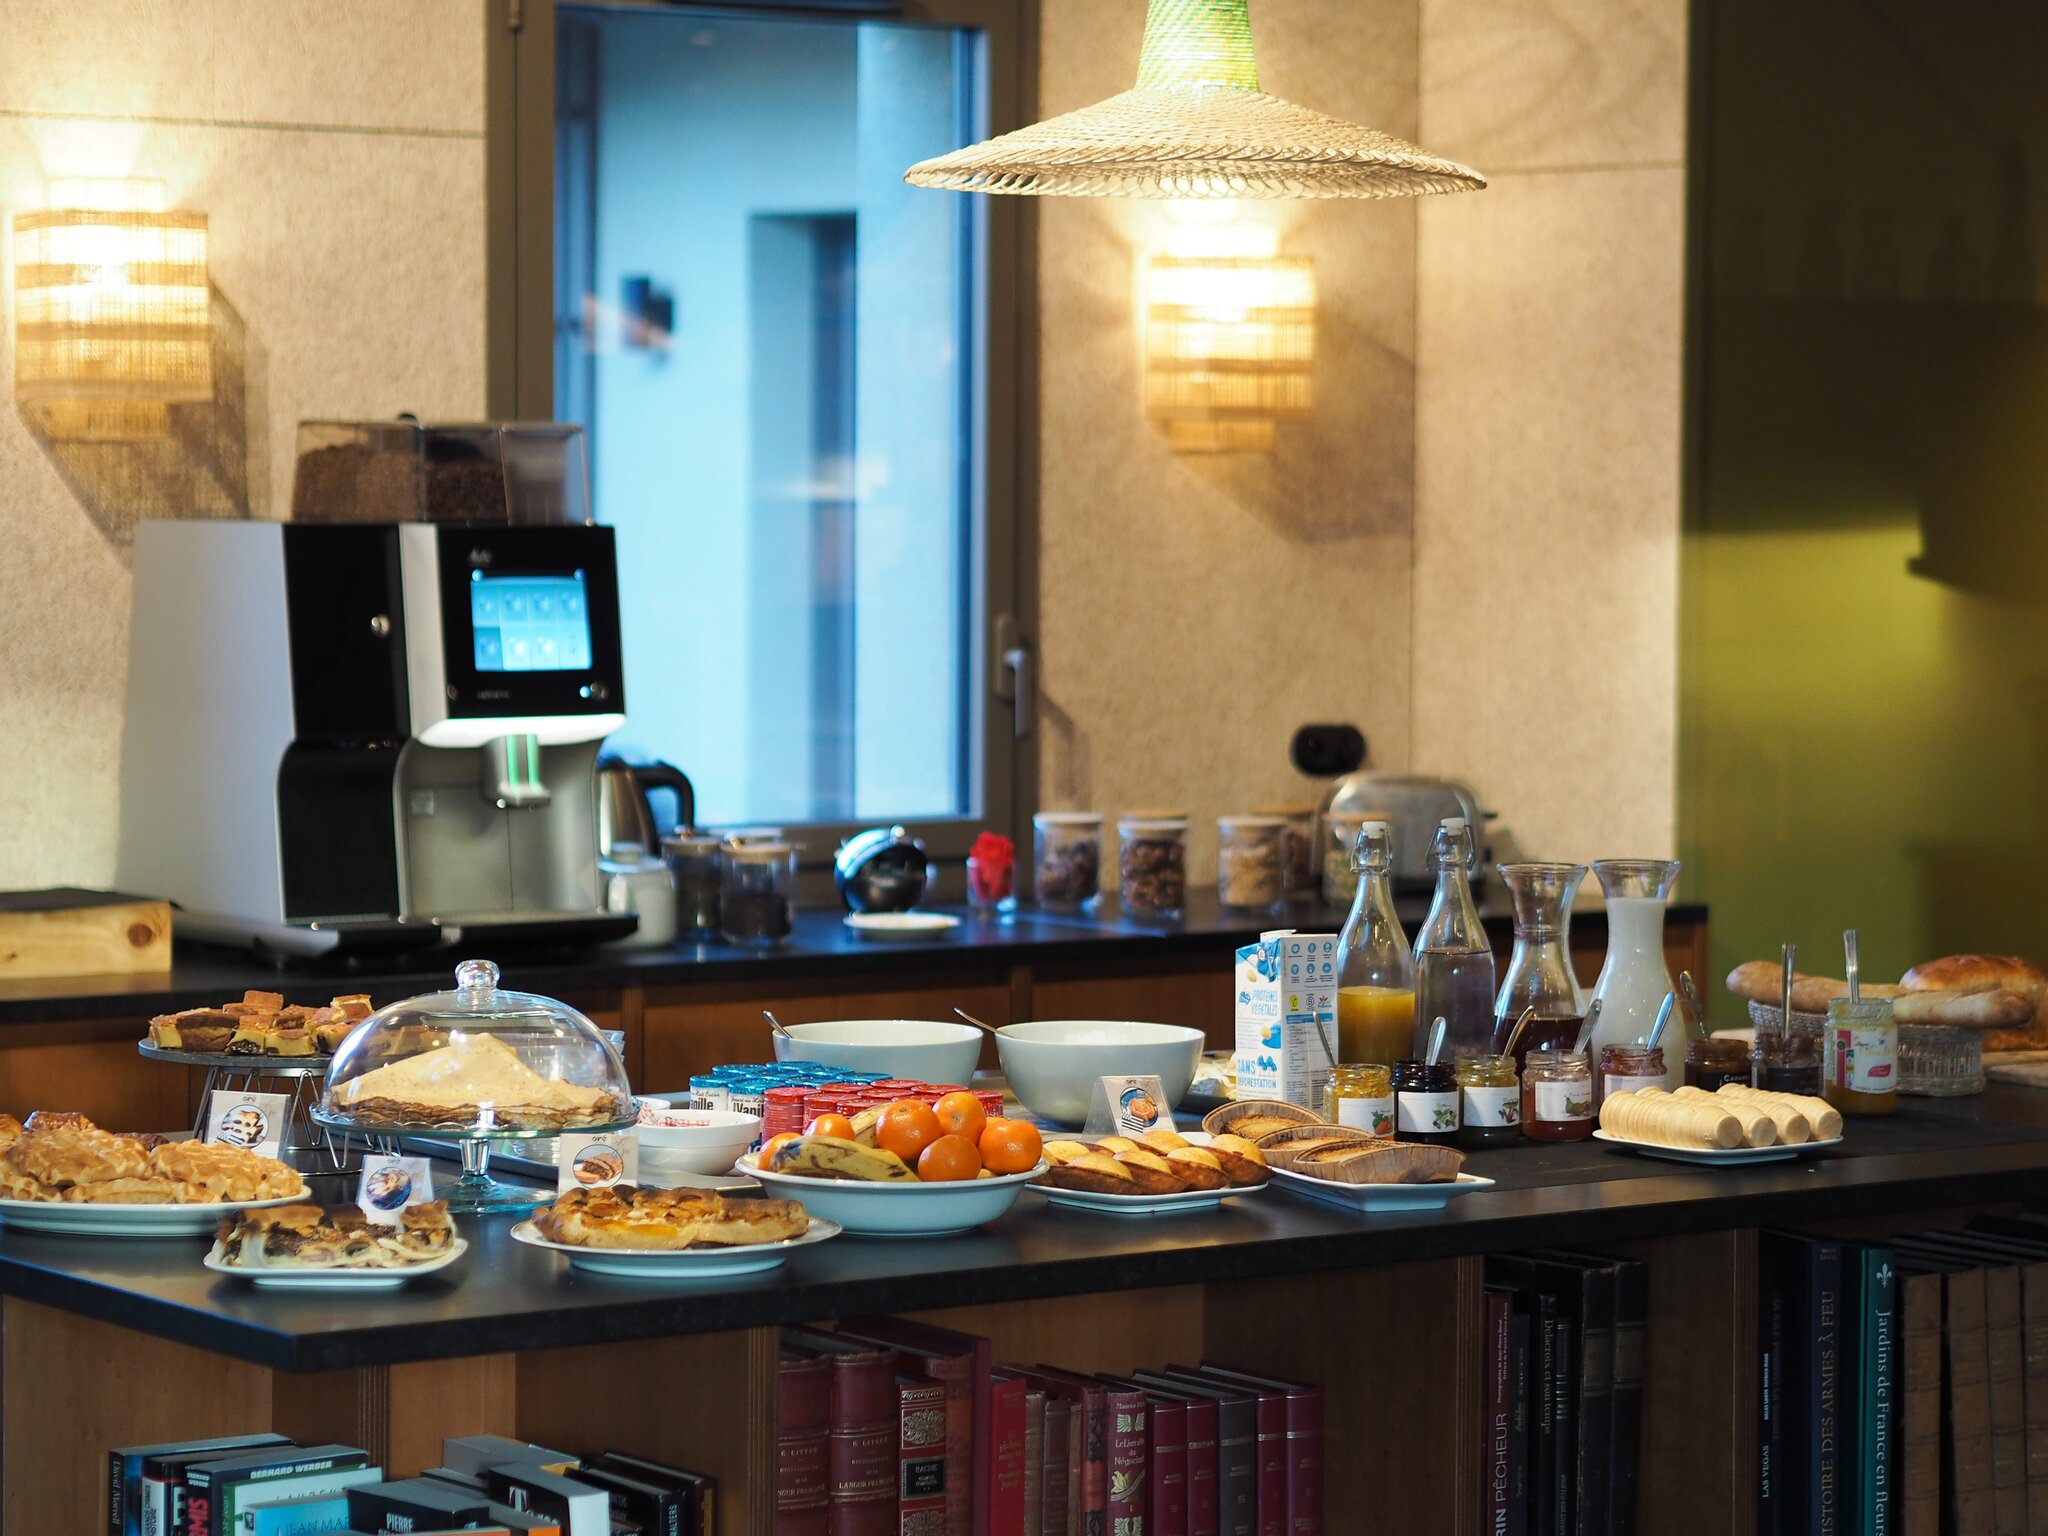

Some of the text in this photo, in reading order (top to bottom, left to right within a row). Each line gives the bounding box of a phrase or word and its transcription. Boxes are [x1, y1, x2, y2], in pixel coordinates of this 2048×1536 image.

[1237, 1058, 1256, 1075] SANS
[1821, 1290, 1835, 1327] FEU
[1817, 1331, 1834, 1344] À
[1541, 1320, 1554, 1434] Delacroix et son temps
[1821, 1350, 1834, 1413] ARMES
[1821, 1416, 1834, 1453] DES
[1875, 1309, 1892, 1536] Jardins de France en fleurs
[250, 1460, 334, 1480] BERNARD WERBER
[1493, 1413, 1508, 1502] PÊCHEUR
[1762, 1445, 1770, 1498] LAS VEGAS
[112, 1461, 121, 1525] David Morrell
